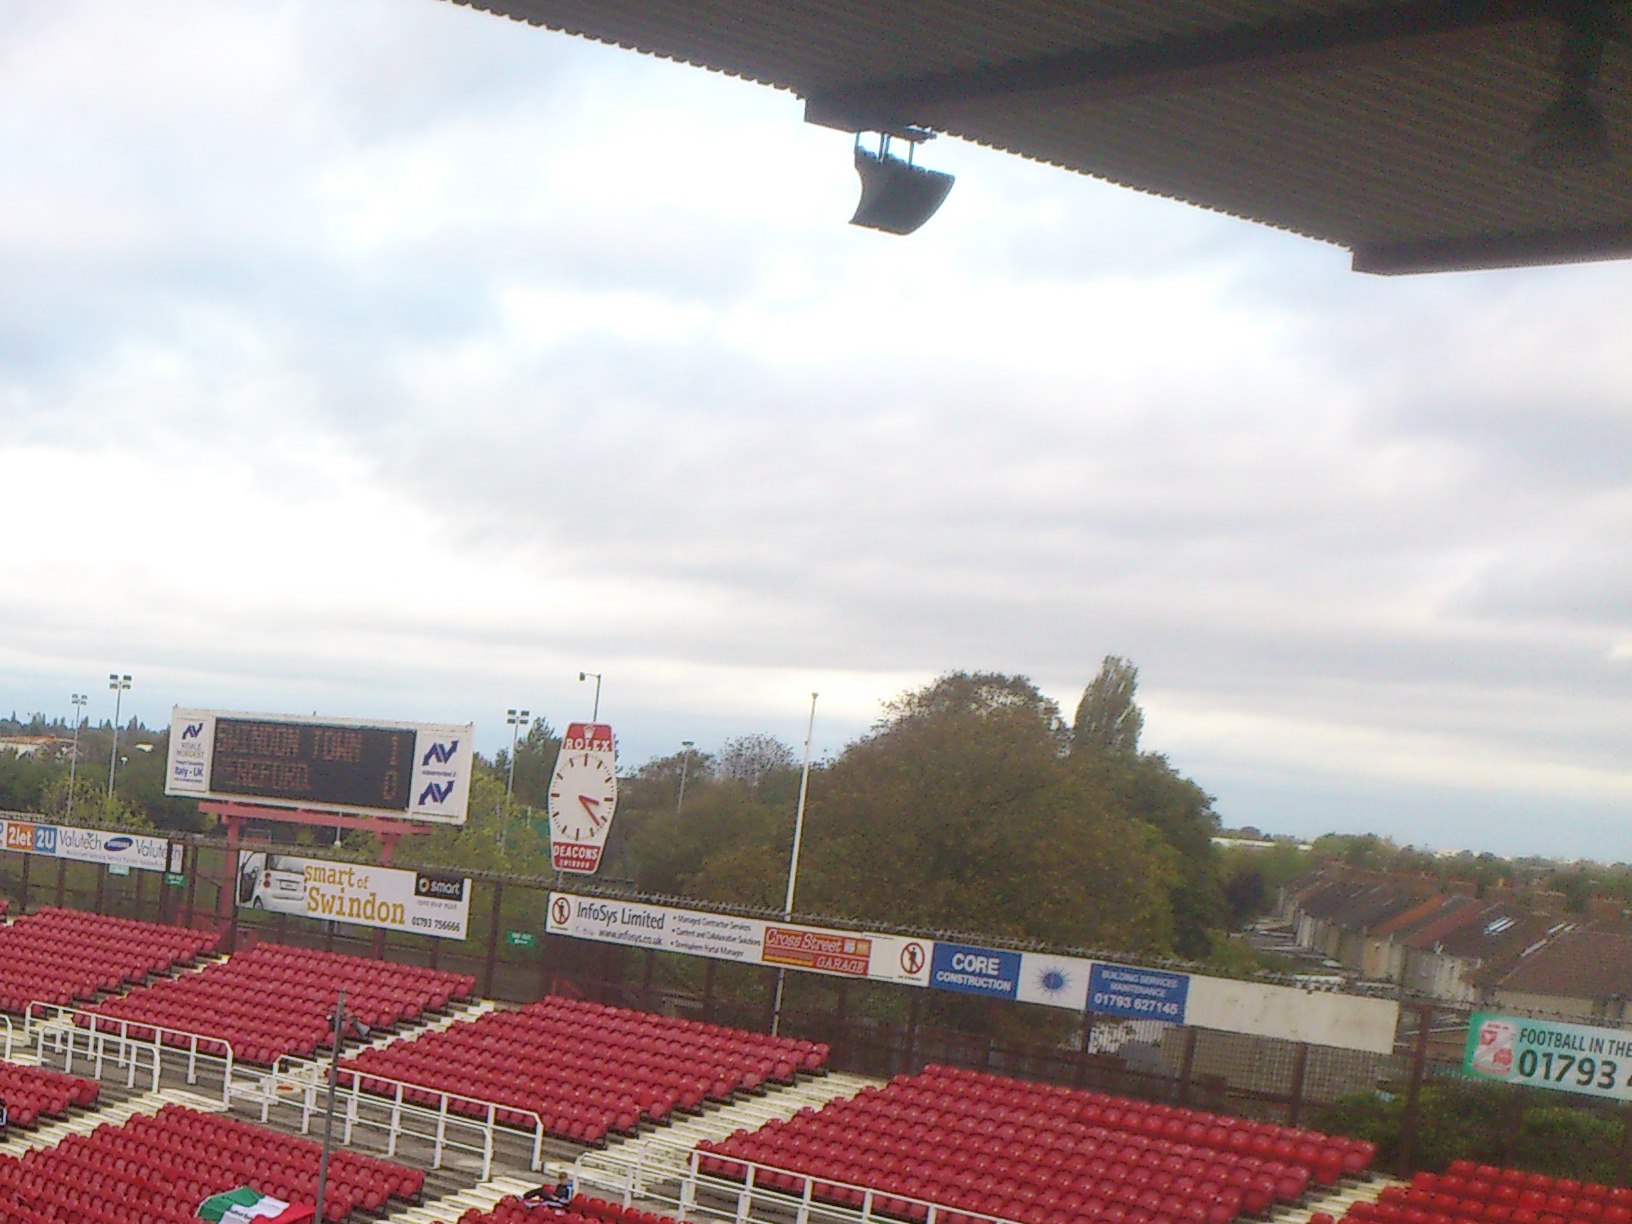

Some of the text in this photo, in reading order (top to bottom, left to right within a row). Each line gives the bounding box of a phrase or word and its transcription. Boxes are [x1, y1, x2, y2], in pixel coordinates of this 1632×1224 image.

[566, 738, 610, 752] ROLEX
[8, 827, 56, 849] 2let 2U
[59, 830, 102, 850] Valutech
[553, 845, 598, 860] DEACONS
[305, 864, 368, 890] smart of
[430, 880, 460, 895] smart
[307, 886, 405, 926] Swindon
[577, 901, 666, 931] InfoSys Limited
[765, 928, 843, 953] Cross Street
[815, 955, 867, 974] GARAGE
[952, 952, 1001, 976] CORE
[935, 971, 1012, 993] CONSTRUCTION
[1094, 992, 1132, 1009] 01793
[1519, 1027, 1586, 1052] FOOTBALL
[1588, 1036, 1605, 1054] IN
[1518, 1048, 1617, 1090] 01793
